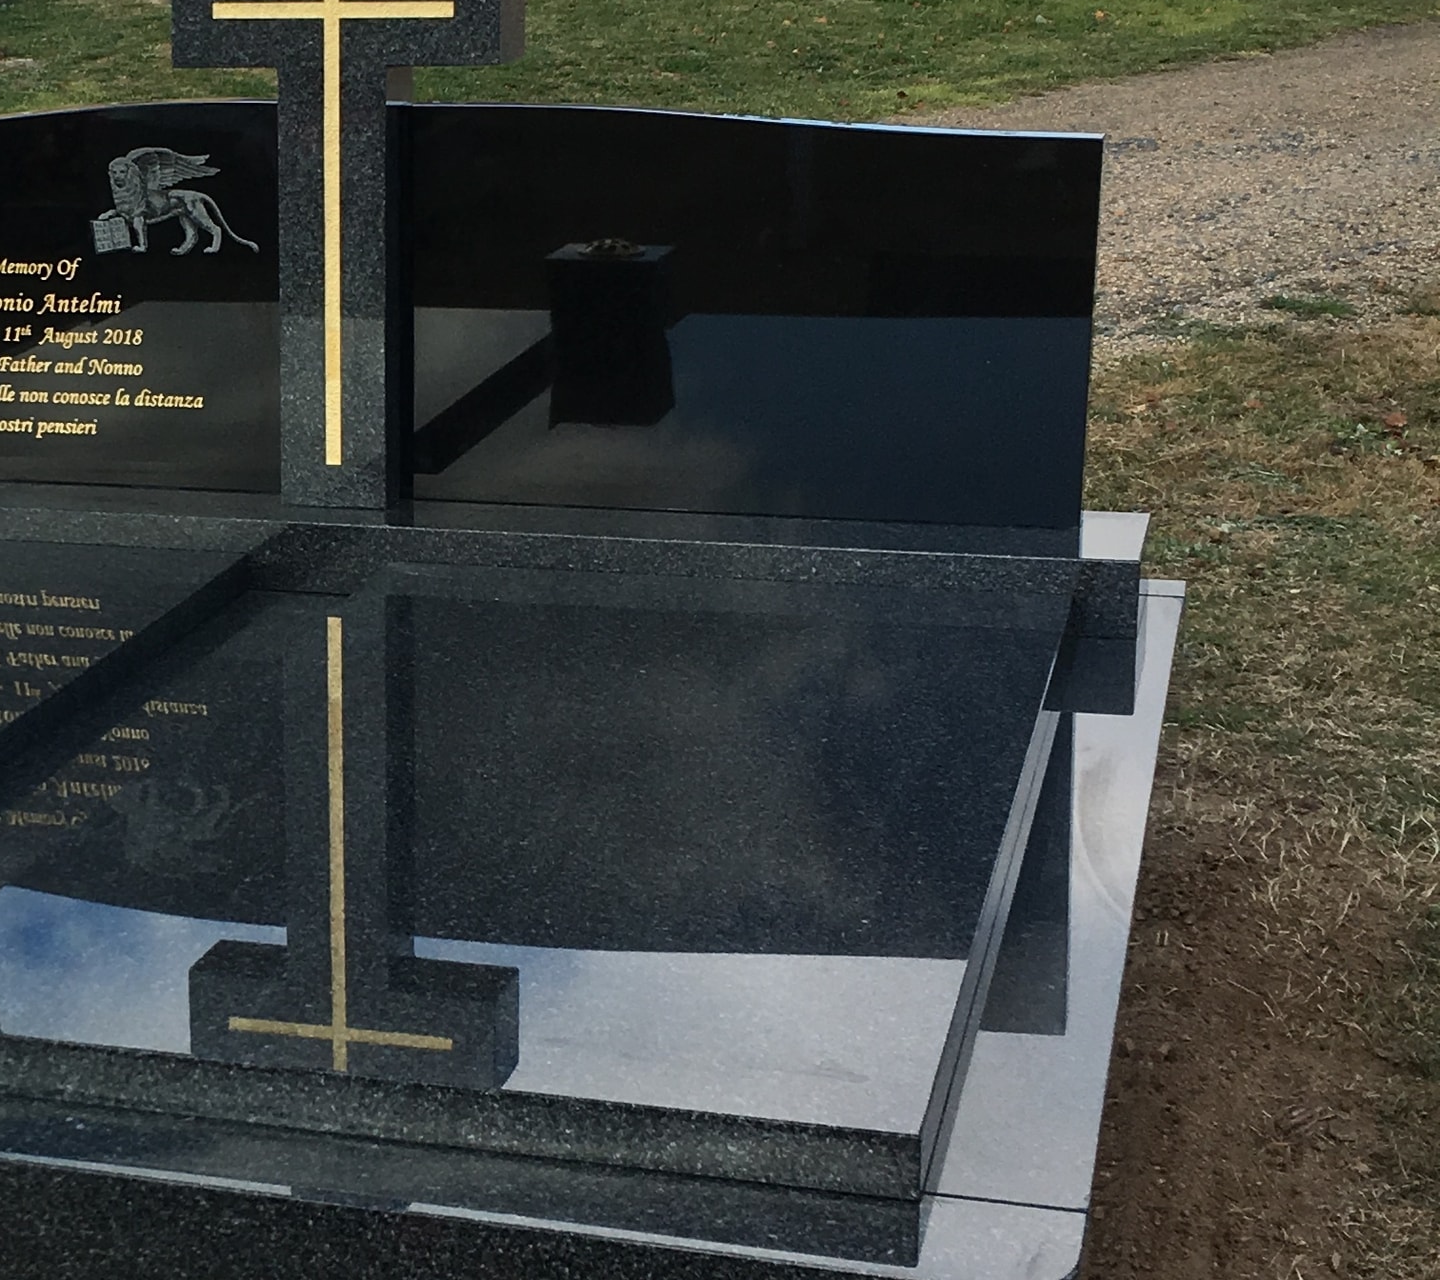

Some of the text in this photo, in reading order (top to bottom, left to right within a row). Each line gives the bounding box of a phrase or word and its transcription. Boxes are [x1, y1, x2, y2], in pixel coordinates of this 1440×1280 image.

[57, 258, 82, 280] Of
[37, 292, 122, 315] Antelmi
[2, 325, 32, 342] 11th
[38, 327, 98, 349] August
[102, 329, 143, 345] 2018
[54, 357, 88, 375] and
[87, 359, 143, 376] Nonno
[19, 391, 48, 403] non
[52, 392, 110, 406] conosce
[115, 388, 130, 406] la
[134, 389, 204, 409] distanza
[36, 418, 98, 438] pensieri
